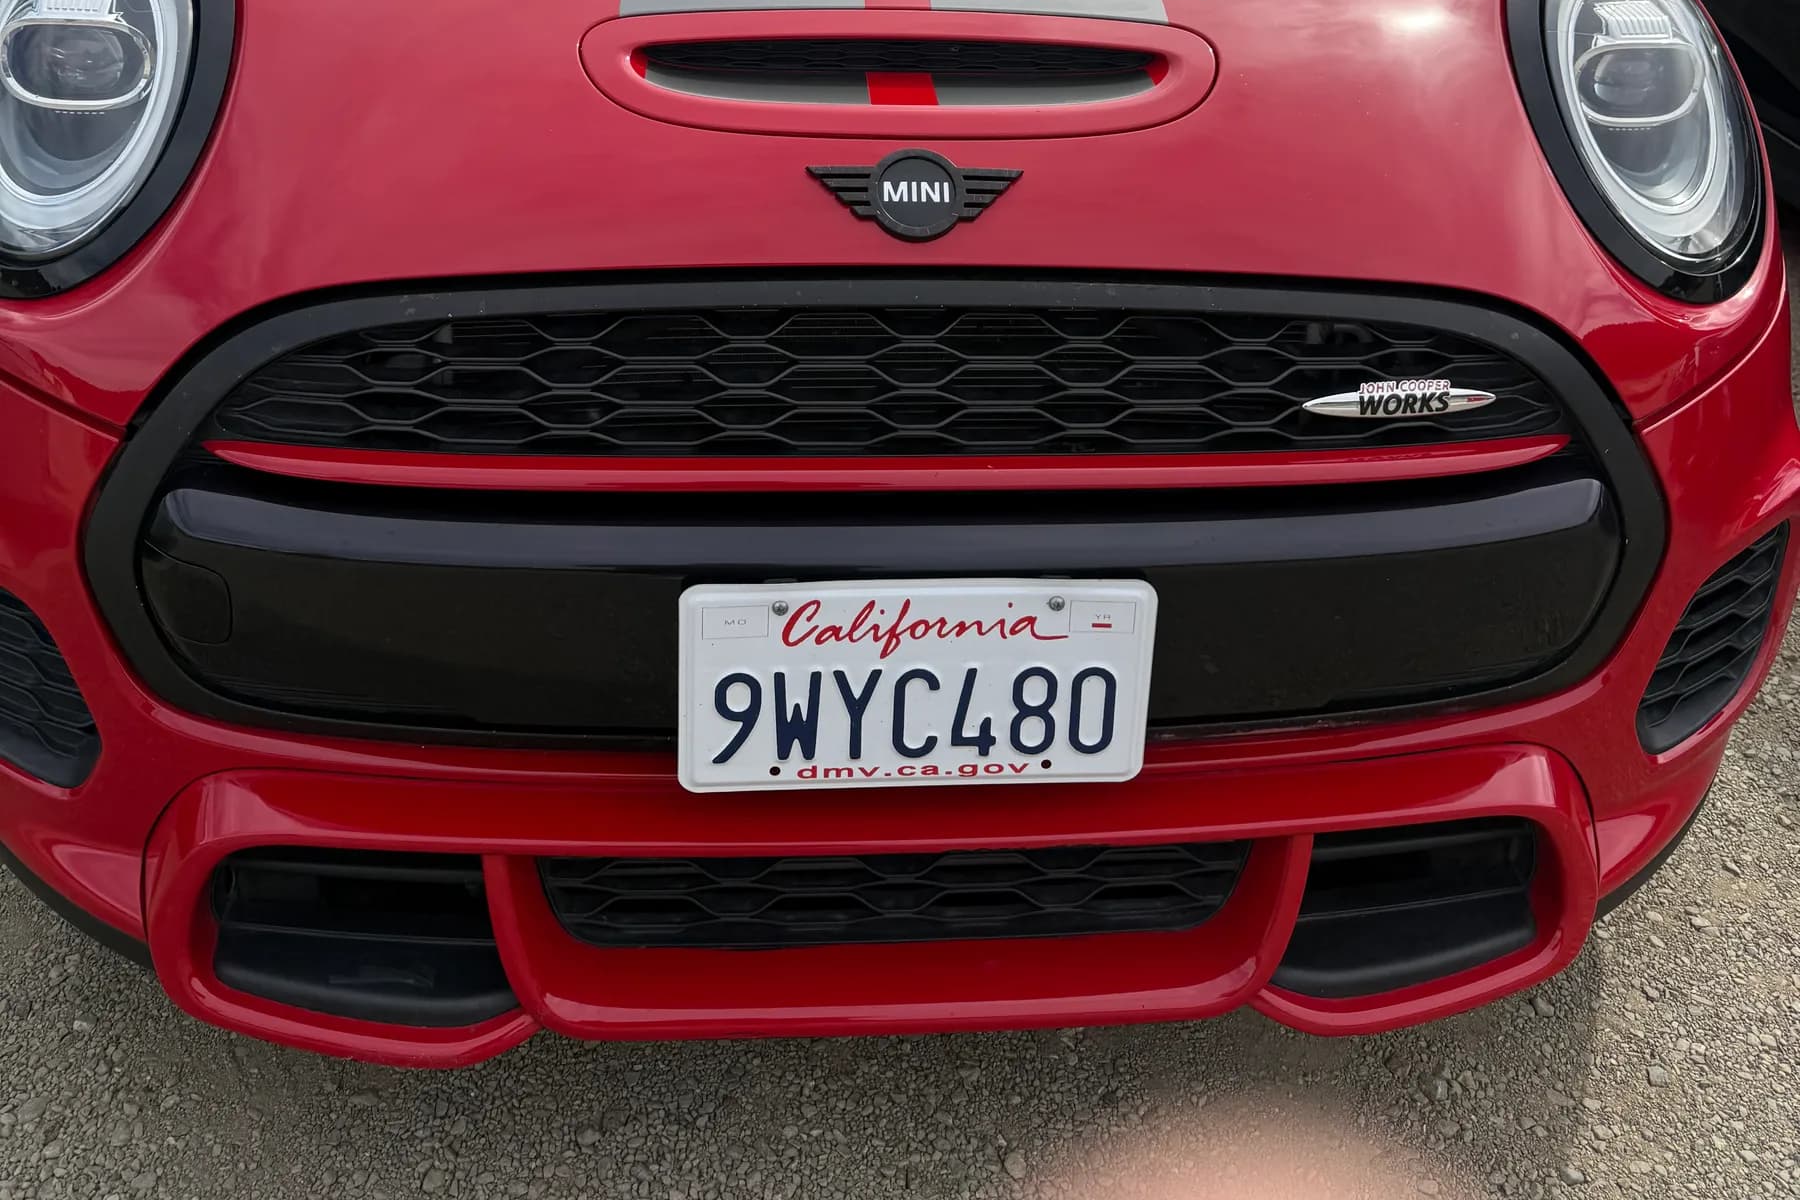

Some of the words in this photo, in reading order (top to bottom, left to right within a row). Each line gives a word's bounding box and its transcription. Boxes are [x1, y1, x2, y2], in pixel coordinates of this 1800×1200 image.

[883, 181, 950, 203] MINI
[1360, 381, 1395, 394] JOHN
[1399, 379, 1451, 393] COOPER
[1358, 391, 1451, 416] WORKS
[782, 599, 1069, 659] California
[712, 666, 1118, 765] 9WYC480
[797, 761, 1031, 780] dmv.ca.gov
